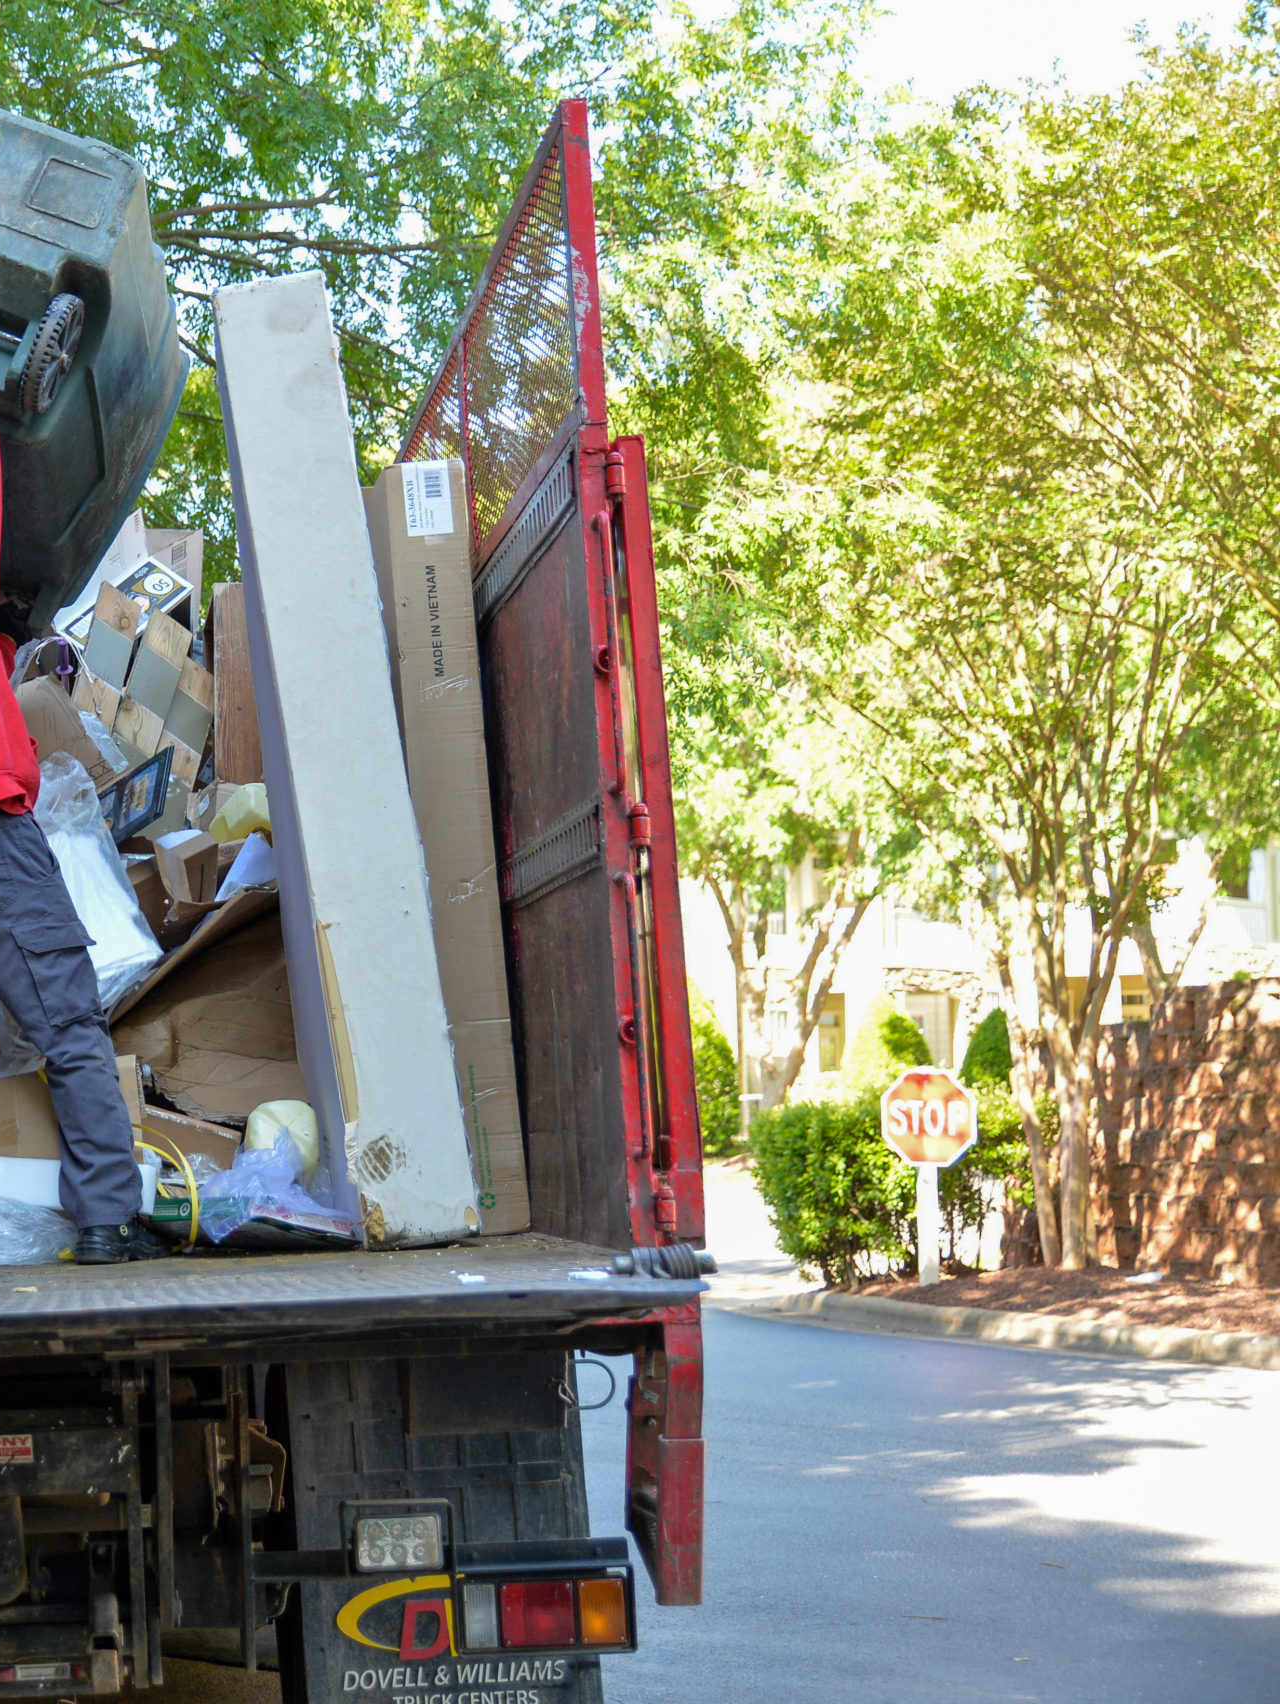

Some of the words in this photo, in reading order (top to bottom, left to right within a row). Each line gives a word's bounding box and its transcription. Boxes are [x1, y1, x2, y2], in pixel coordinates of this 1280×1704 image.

[152, 577, 171, 592] 50
[425, 565, 440, 622] VIETNAM
[431, 625, 441, 638] IN
[431, 641, 445, 677] MADE
[888, 1098, 969, 1137] STOP
[343, 1666, 429, 1691] DOVELL
[434, 1665, 450, 1686] &
[456, 1659, 566, 1685] WILLIAMS
[455, 1690, 540, 1704] CENTERS
